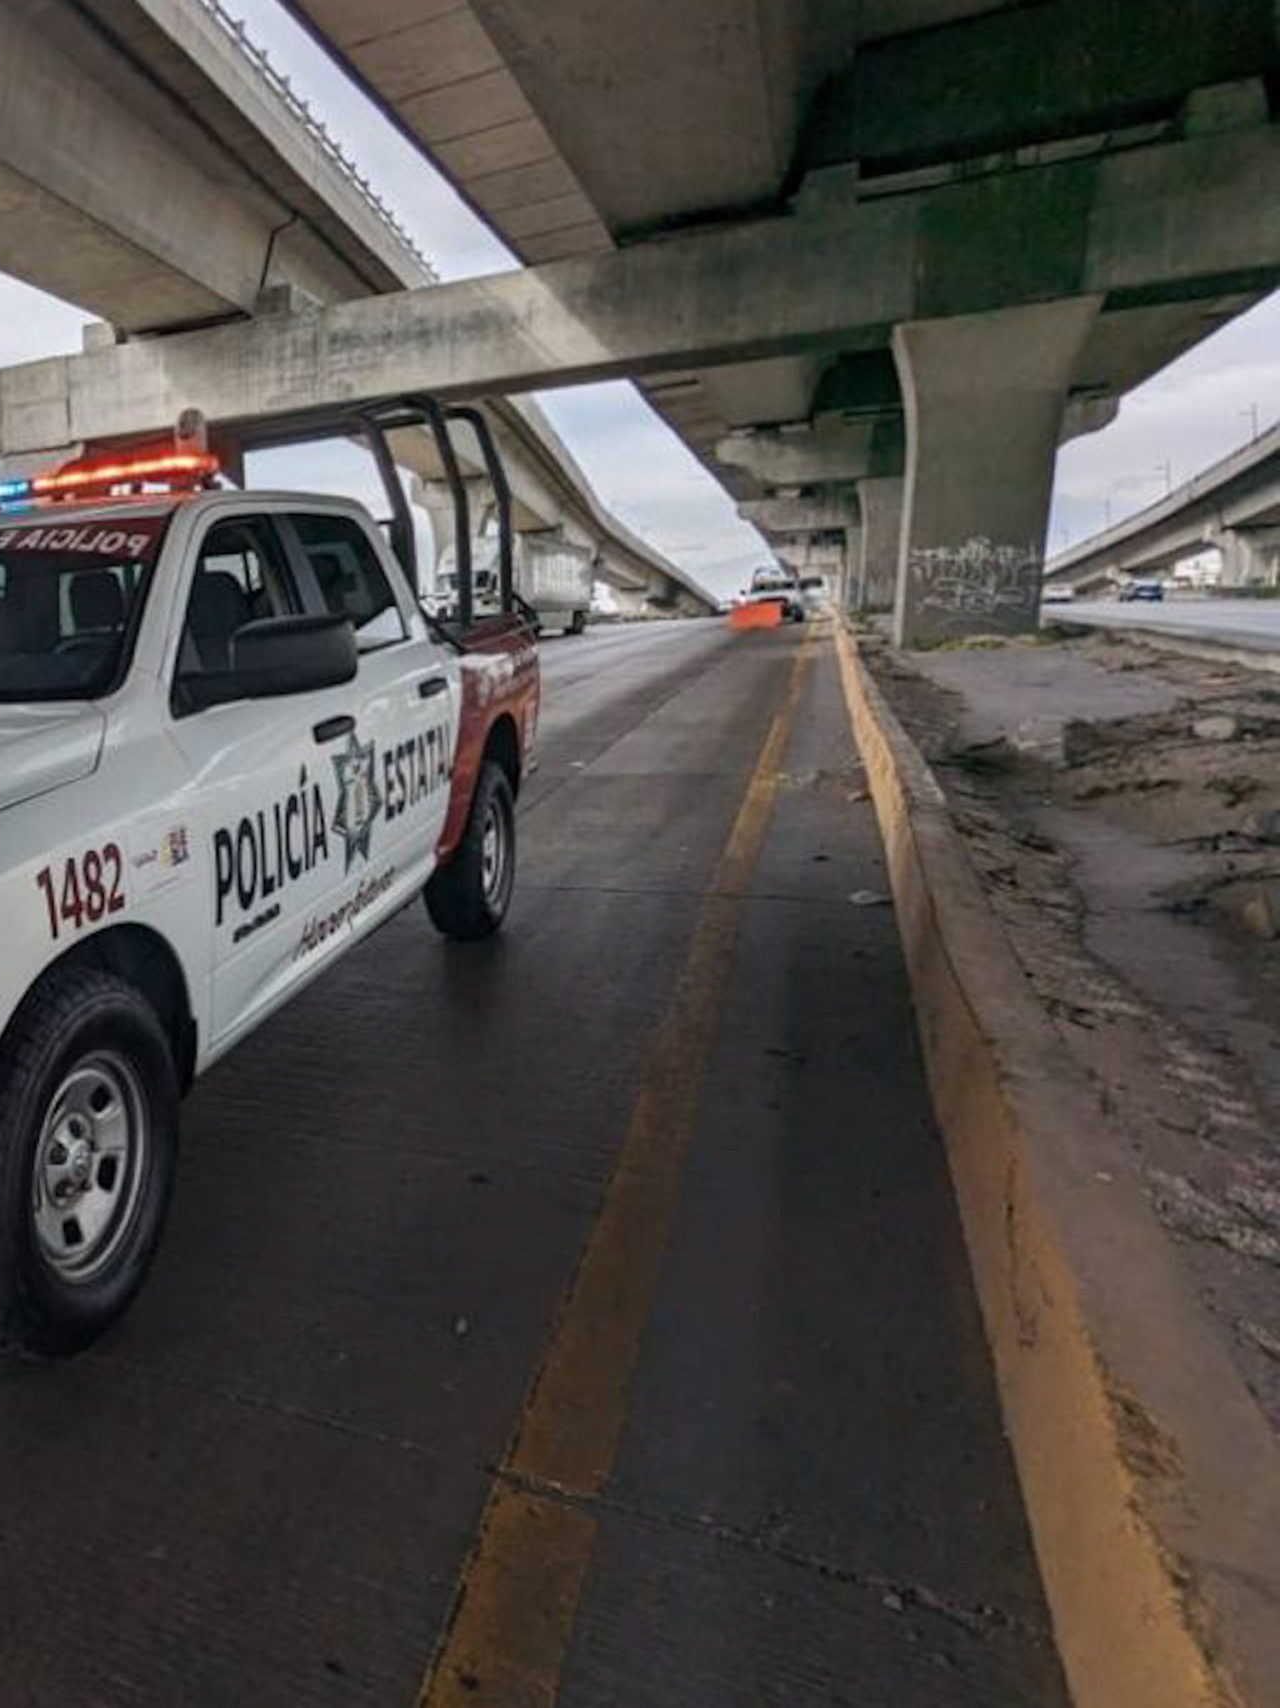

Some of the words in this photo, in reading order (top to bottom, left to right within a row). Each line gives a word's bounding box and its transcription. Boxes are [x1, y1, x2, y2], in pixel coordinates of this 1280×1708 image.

[36, 842, 125, 940] 1482
[214, 763, 327, 927] POLICÍA
[383, 721, 454, 821] ESTATAL
